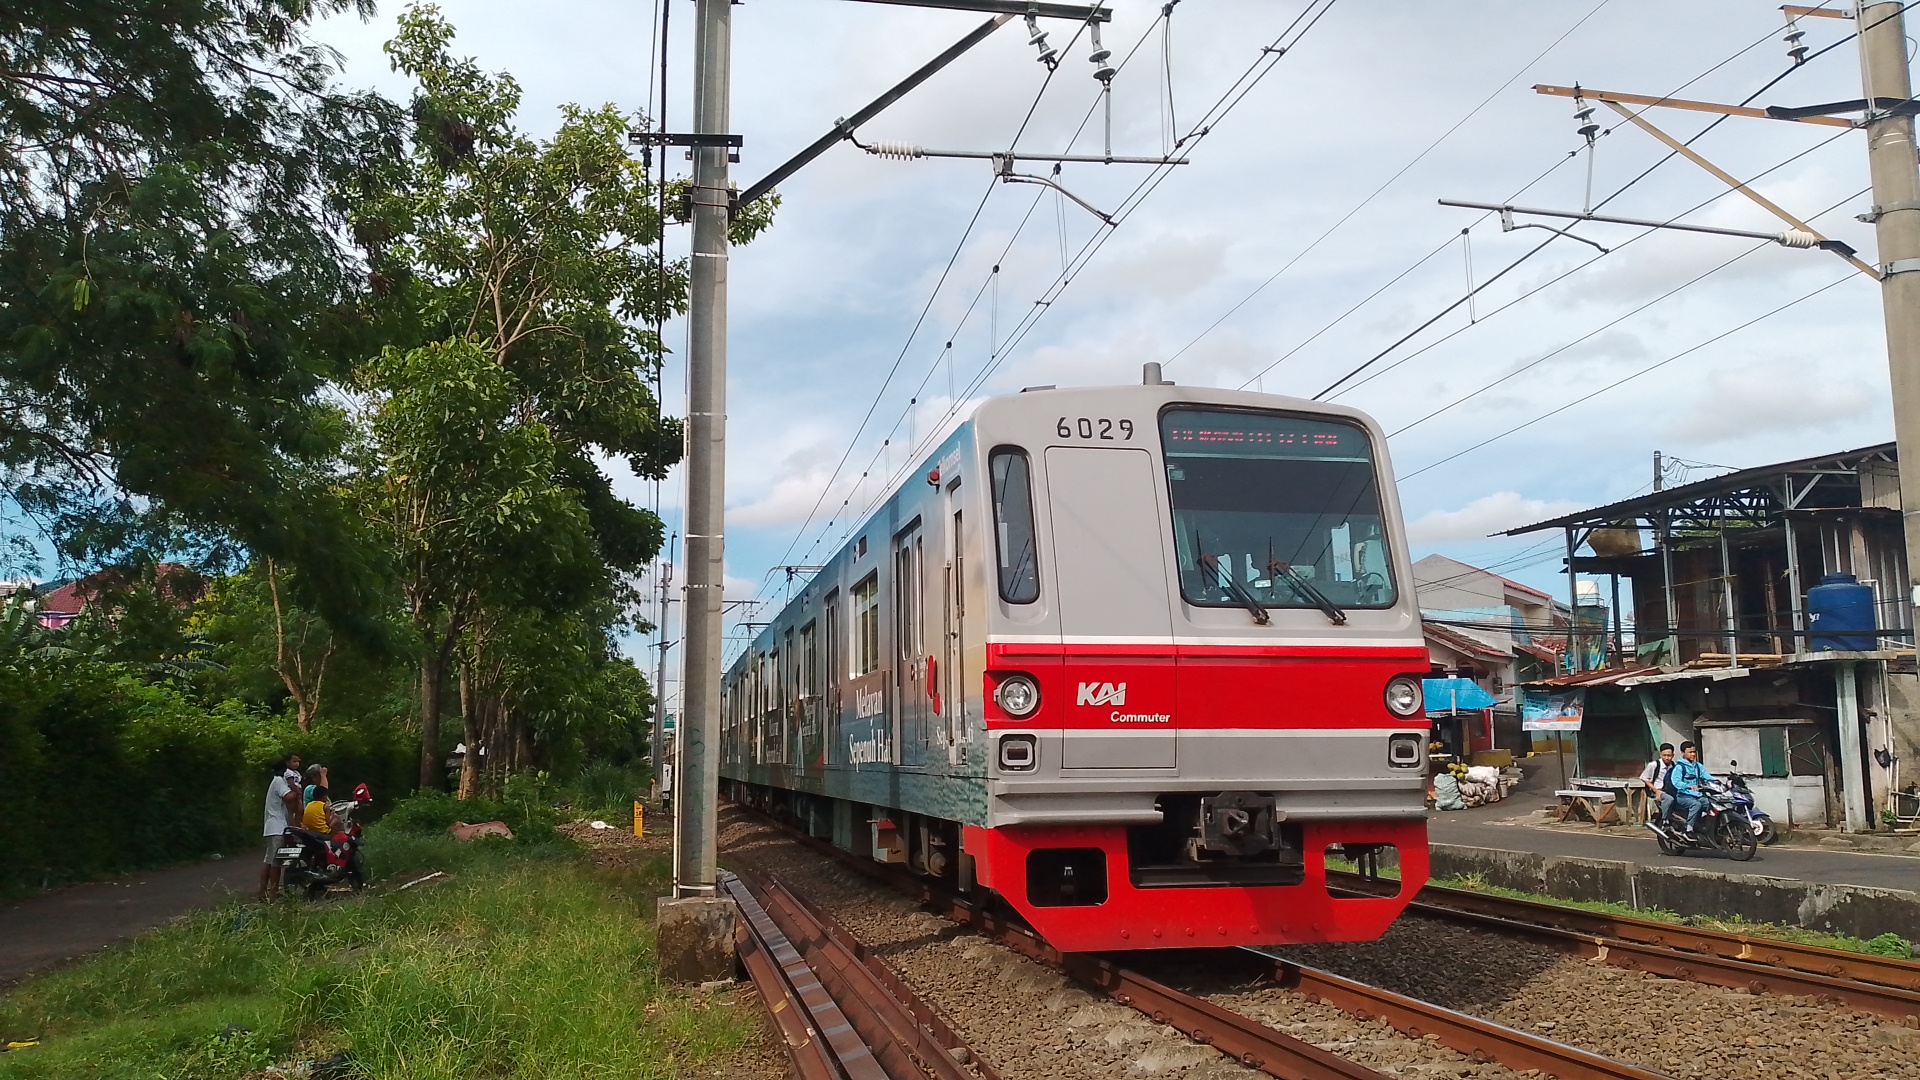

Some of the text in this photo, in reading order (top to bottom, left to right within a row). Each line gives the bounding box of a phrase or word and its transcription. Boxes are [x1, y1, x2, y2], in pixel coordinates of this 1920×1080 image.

[1056, 417, 1134, 441] 6029
[1076, 682, 1127, 706] KAI
[1110, 711, 1171, 723] Commuter
